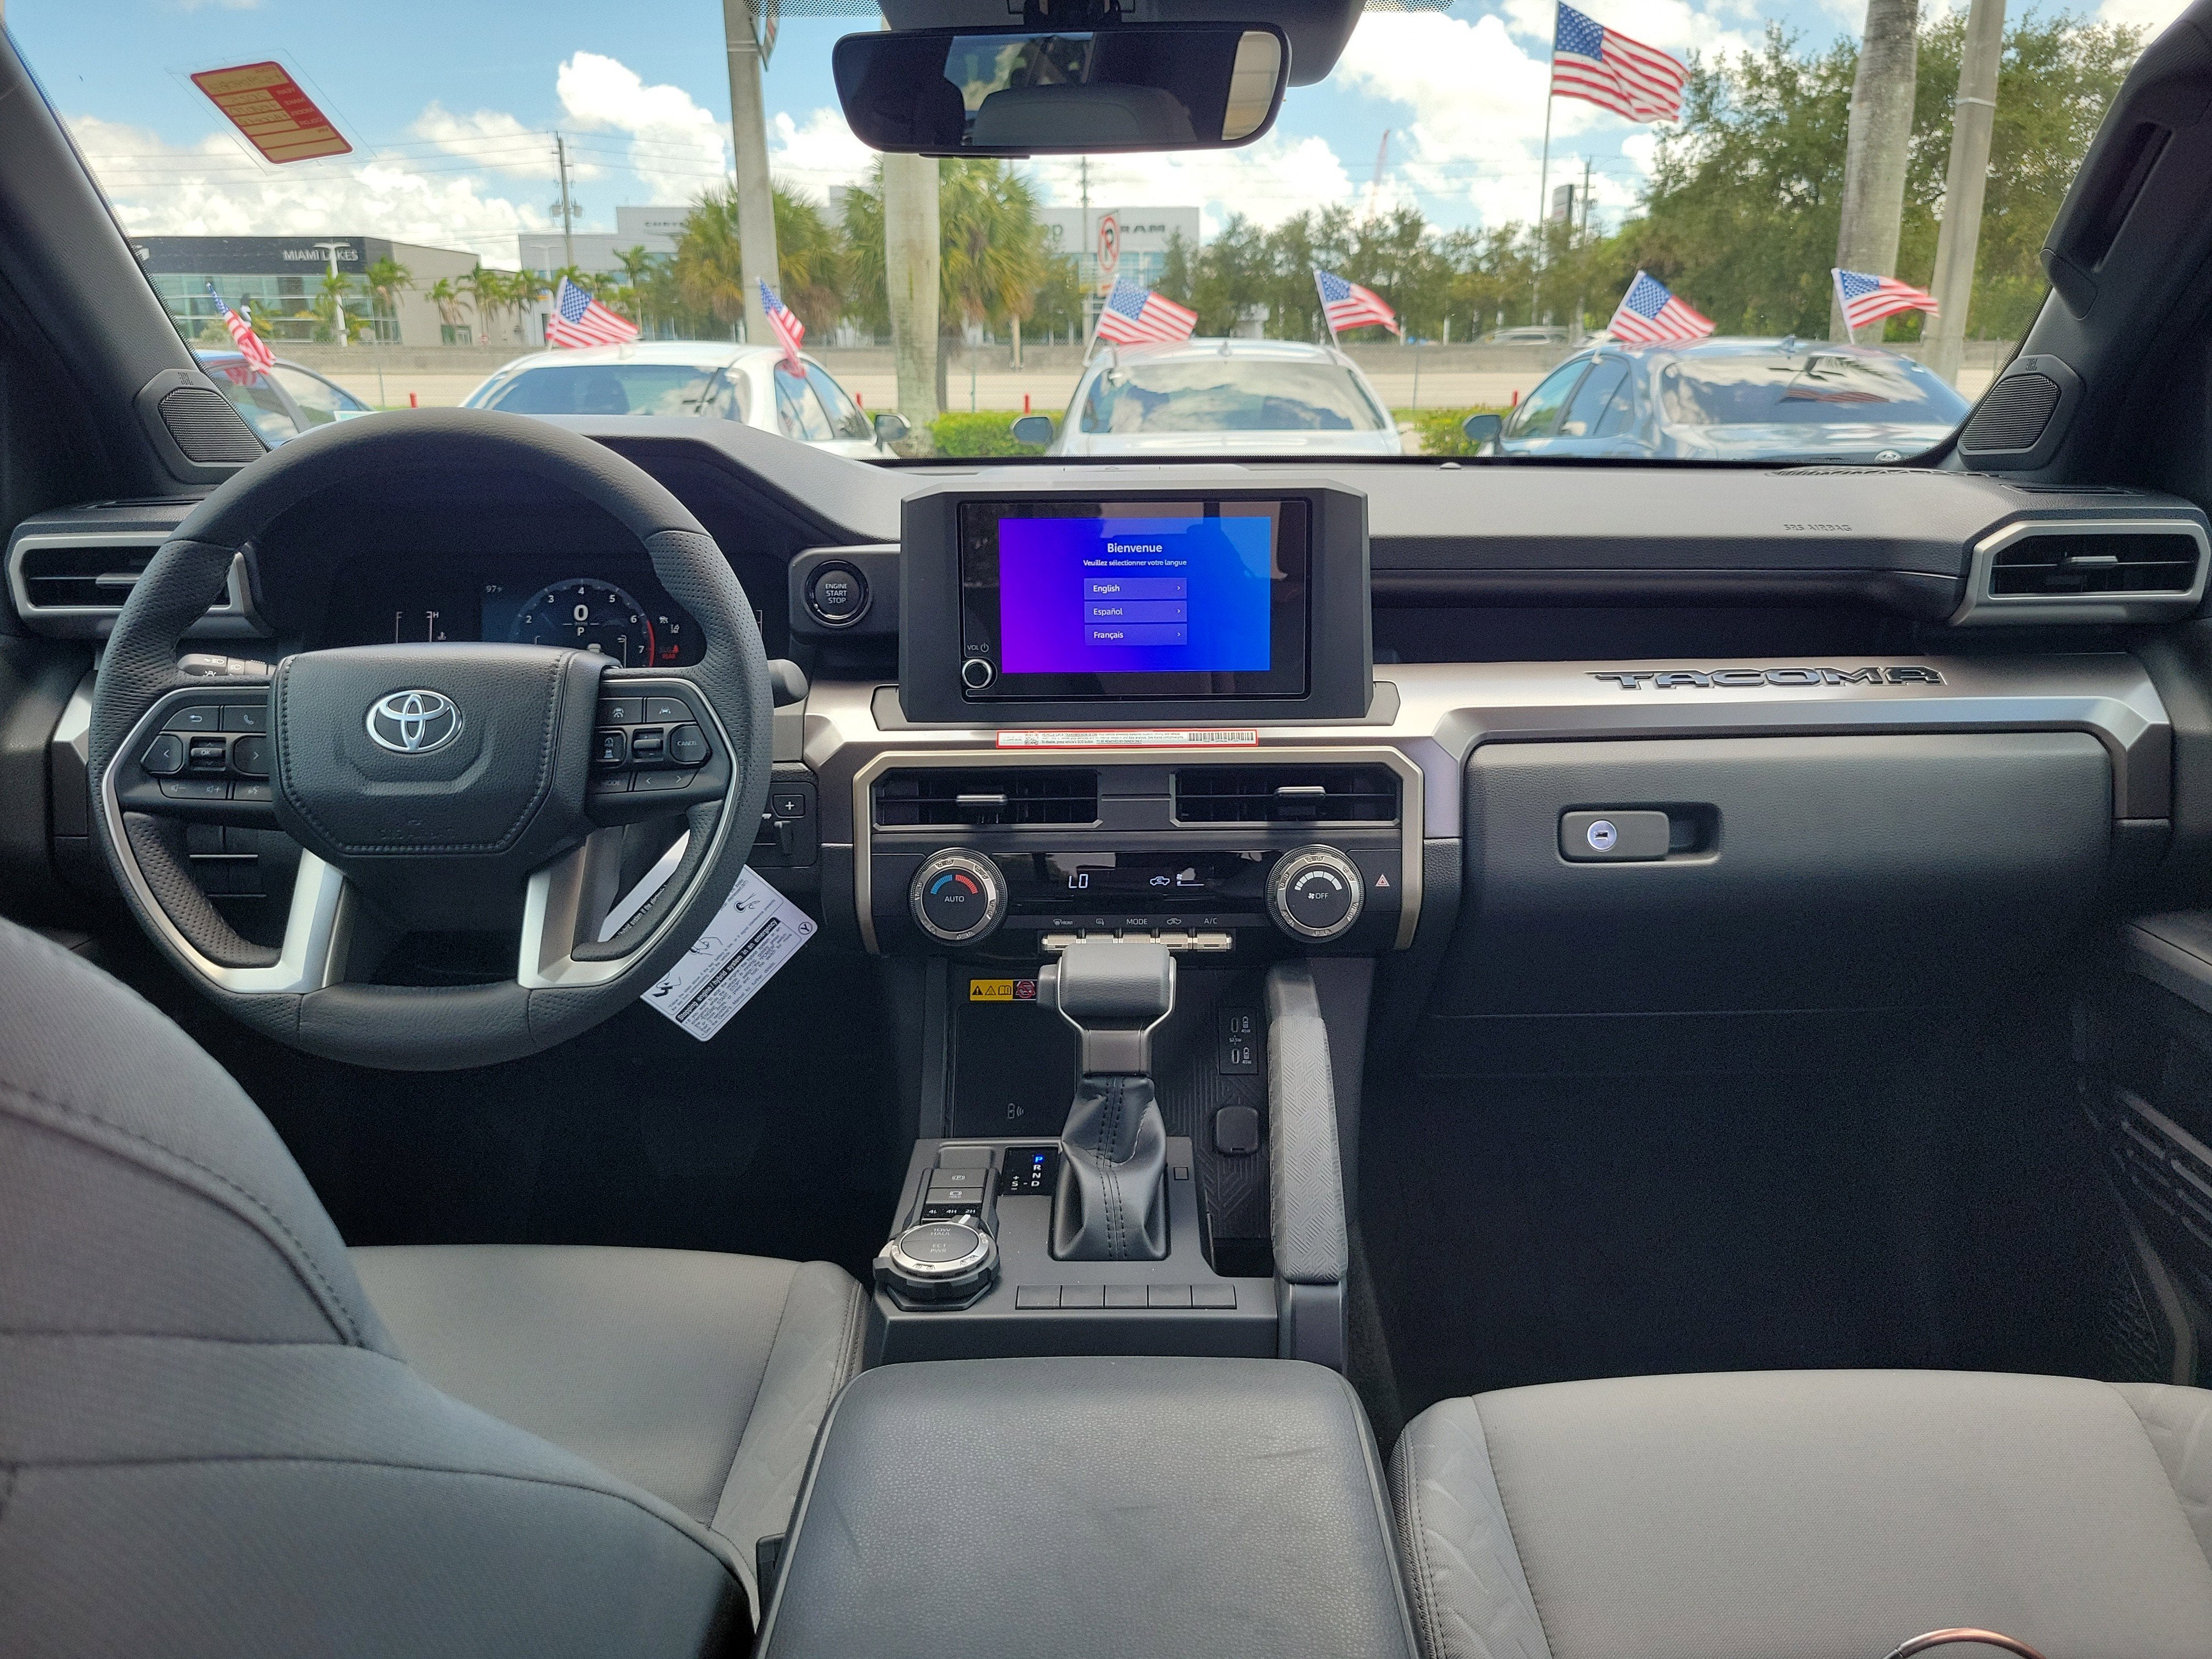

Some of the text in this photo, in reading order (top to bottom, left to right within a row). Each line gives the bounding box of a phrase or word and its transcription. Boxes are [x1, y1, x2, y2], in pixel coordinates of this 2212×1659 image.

[1120, 225, 1165, 233] RAM
[284, 249, 359, 261] MIAMI LKES
[178, 372, 193, 385] JBL
[1809, 524, 1852, 532] AIRBAG
[1107, 543, 1163, 552] Bienvenue
[1165, 559, 1187, 567] langue
[578, 586, 584, 595] 4
[1093, 585, 1120, 594] English
[548, 595, 554, 603] 3
[573, 604, 589, 622] 0
[1093, 608, 1122, 617] Español
[630, 615, 637, 623] 6
[577, 627, 585, 636] P
[1093, 631, 1124, 640] Français
[1595, 666, 1946, 690] TACOMA
[1068, 873, 1088, 889] LO
[799, 923, 812, 933] Y
[677, 1000, 699, 1020] Stopping
[711, 969, 730, 986] hybrid
[725, 954, 744, 972] system
[752, 919, 780, 944] emergency
